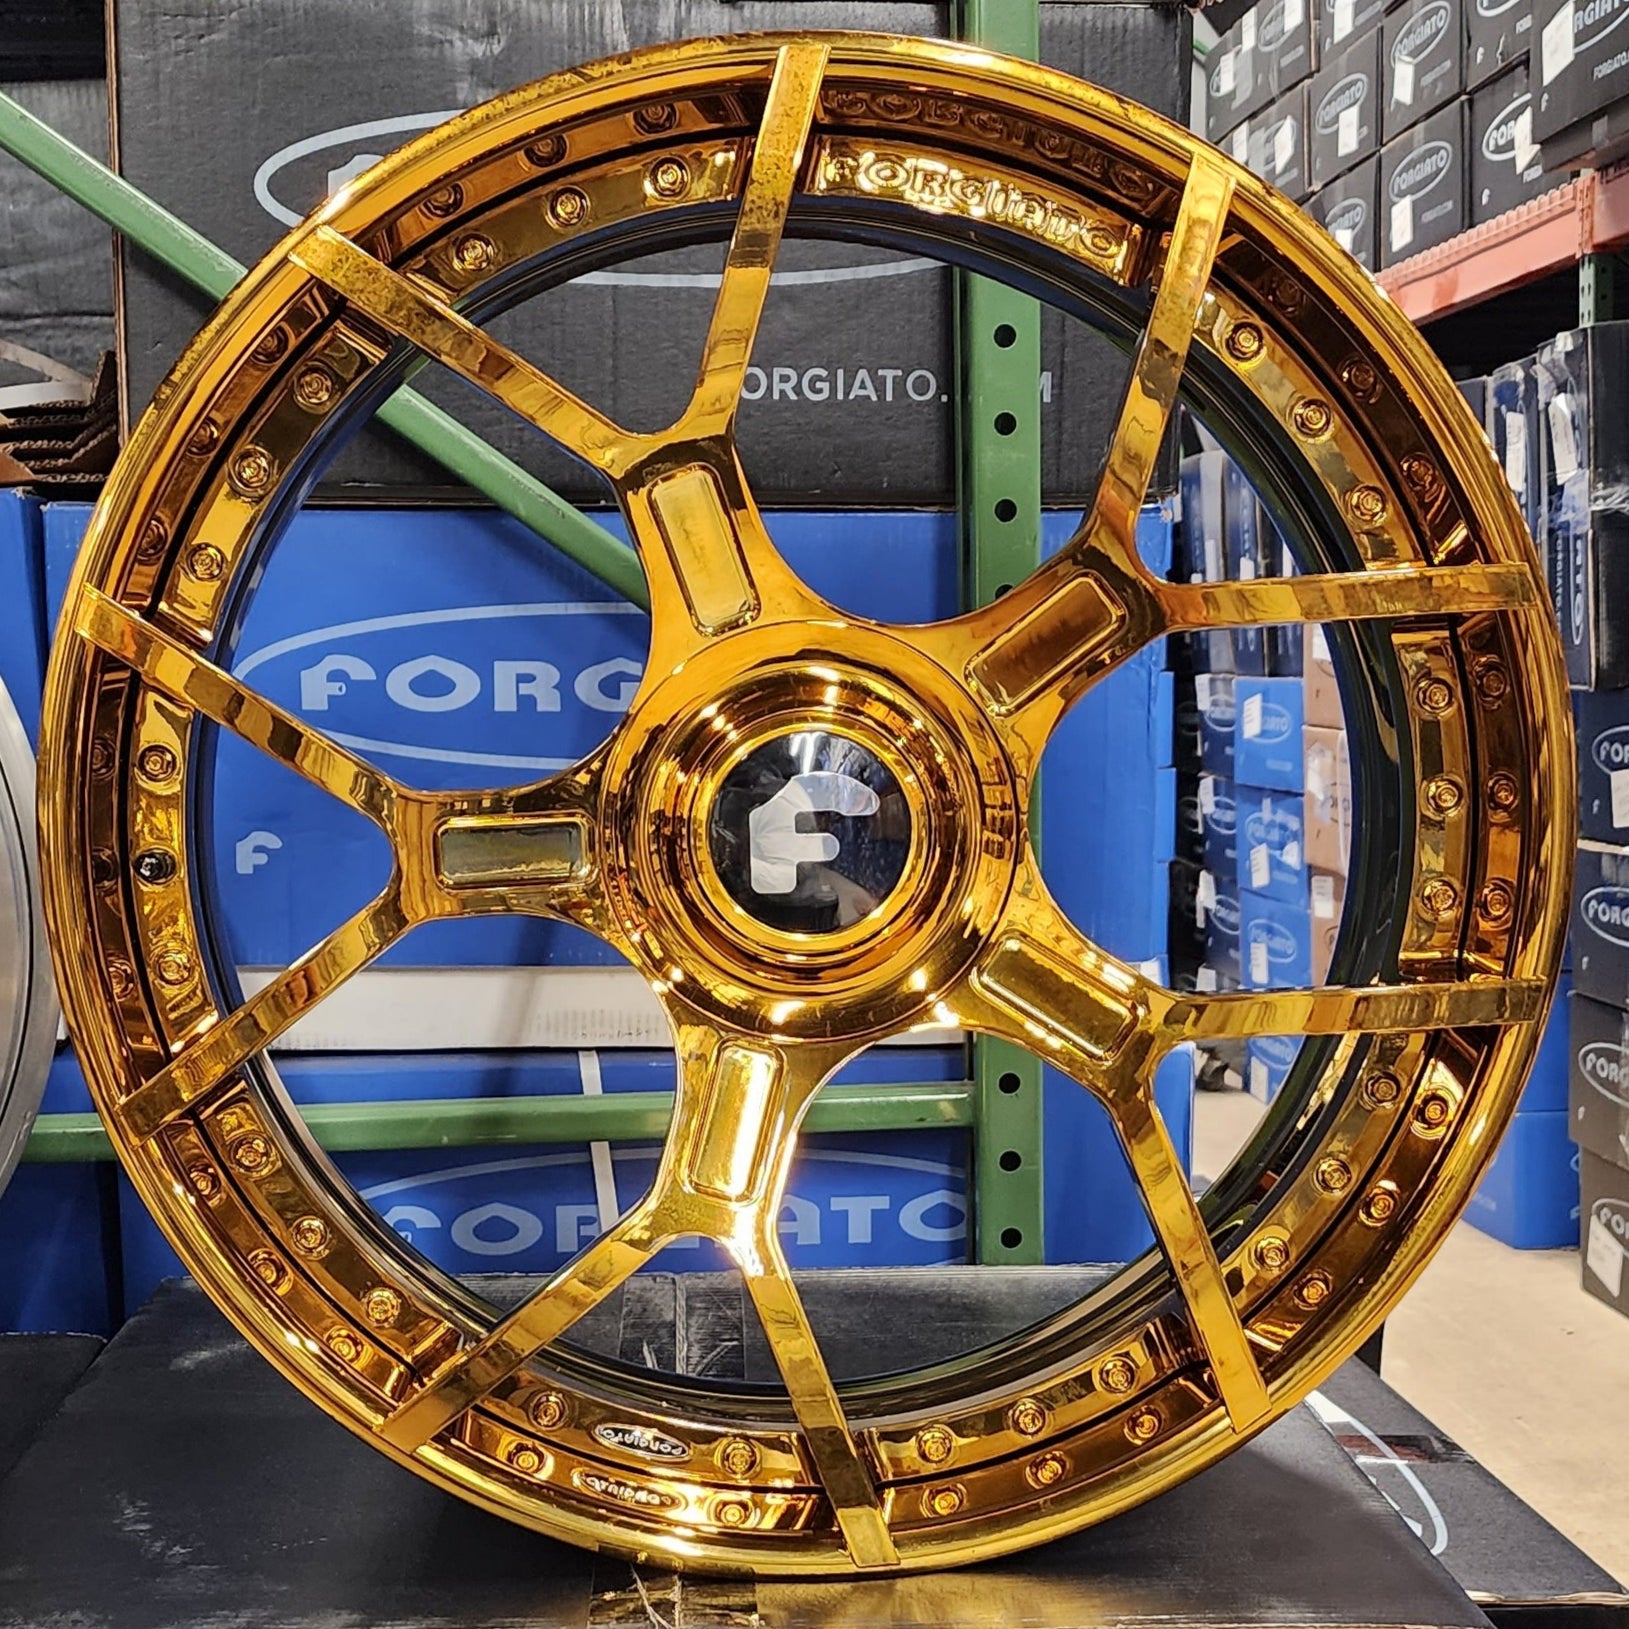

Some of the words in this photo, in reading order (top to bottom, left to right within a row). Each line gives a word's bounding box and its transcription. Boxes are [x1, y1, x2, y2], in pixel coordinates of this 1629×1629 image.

[1574, 0, 1620, 33] RGIA
[1394, 149, 1447, 195] FORGIATO
[741, 367, 1051, 403] ORGIATO.
[300, 654, 643, 712] FORG
[1588, 899, 1629, 928] FORG
[383, 1190, 966, 1256] FORATO
